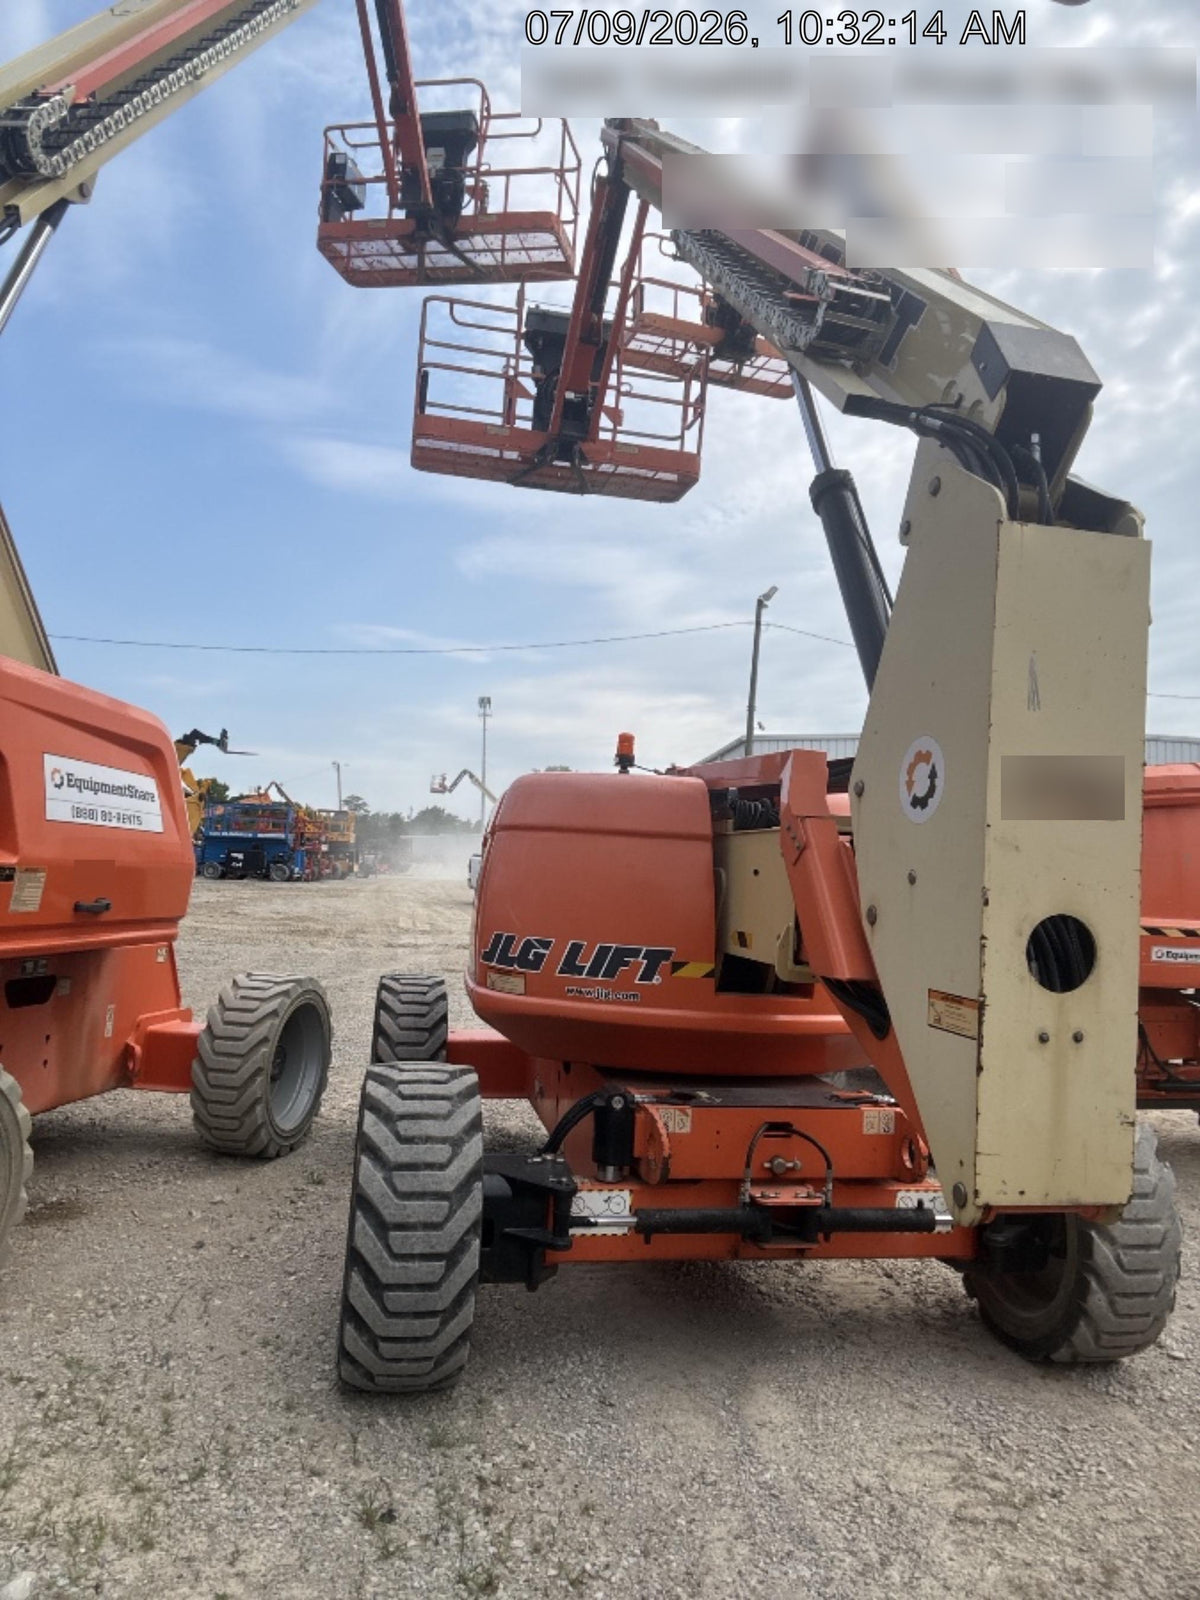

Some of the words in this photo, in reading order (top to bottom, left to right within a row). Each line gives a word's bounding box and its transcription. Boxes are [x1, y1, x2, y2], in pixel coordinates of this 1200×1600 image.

[65, 772, 156, 803] EquipmentShare
[480, 931, 555, 973] JLG
[555, 940, 676, 984] LIFT
[565, 986, 640, 1001] www.jlg.com
